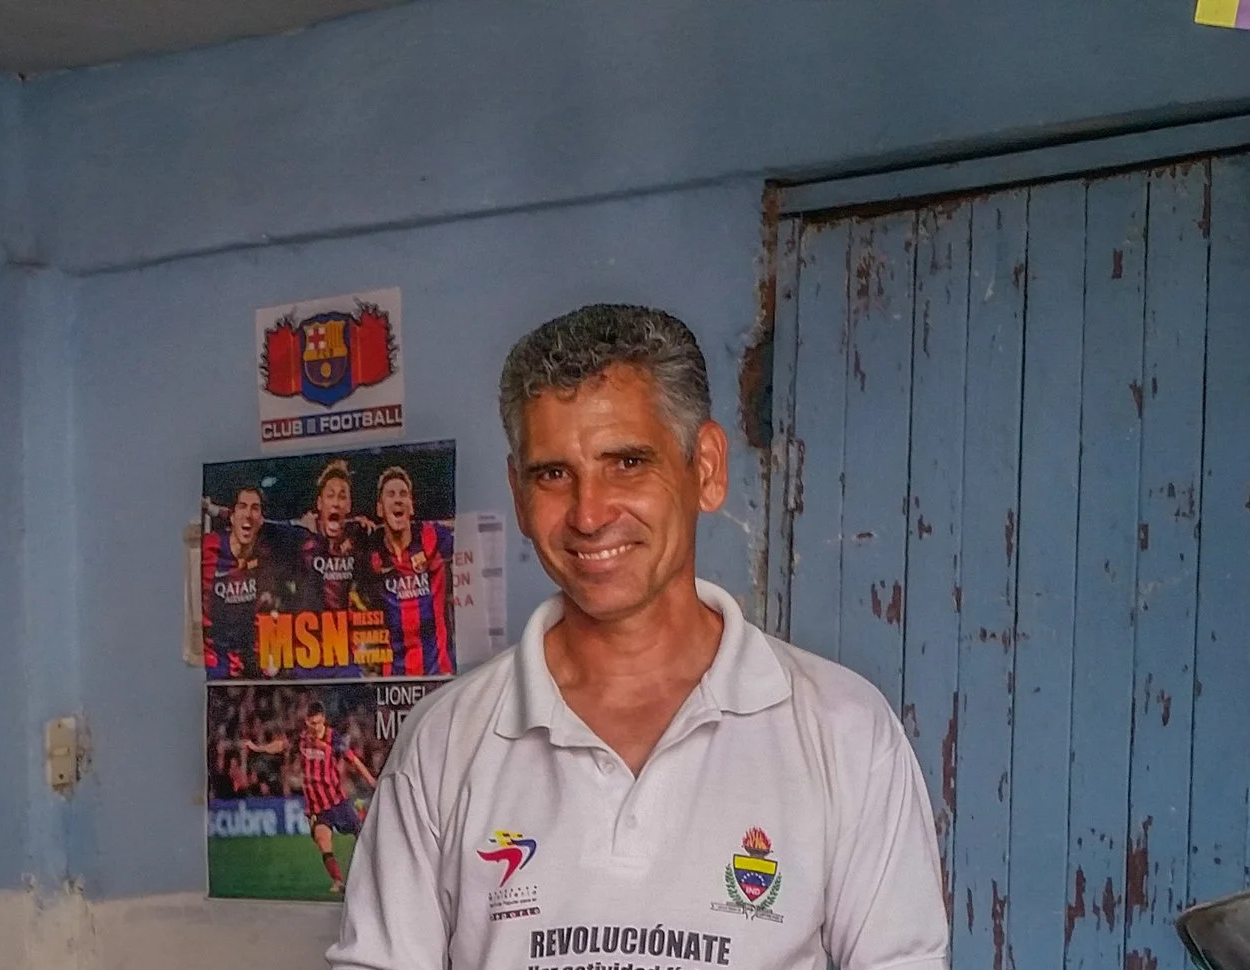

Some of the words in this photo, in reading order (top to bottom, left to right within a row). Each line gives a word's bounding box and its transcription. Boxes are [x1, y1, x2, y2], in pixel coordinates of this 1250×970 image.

[261, 420, 303, 440] CLUB
[319, 407, 403, 434] FOOTBALL
[313, 555, 355, 574] QATAR
[214, 578, 257, 600] QATAR
[385, 572, 430, 596] QATAR
[352, 610, 385, 626] MESSI
[258, 610, 349, 669] MSN
[530, 924, 731, 965] REVOLUCIÓNATE
